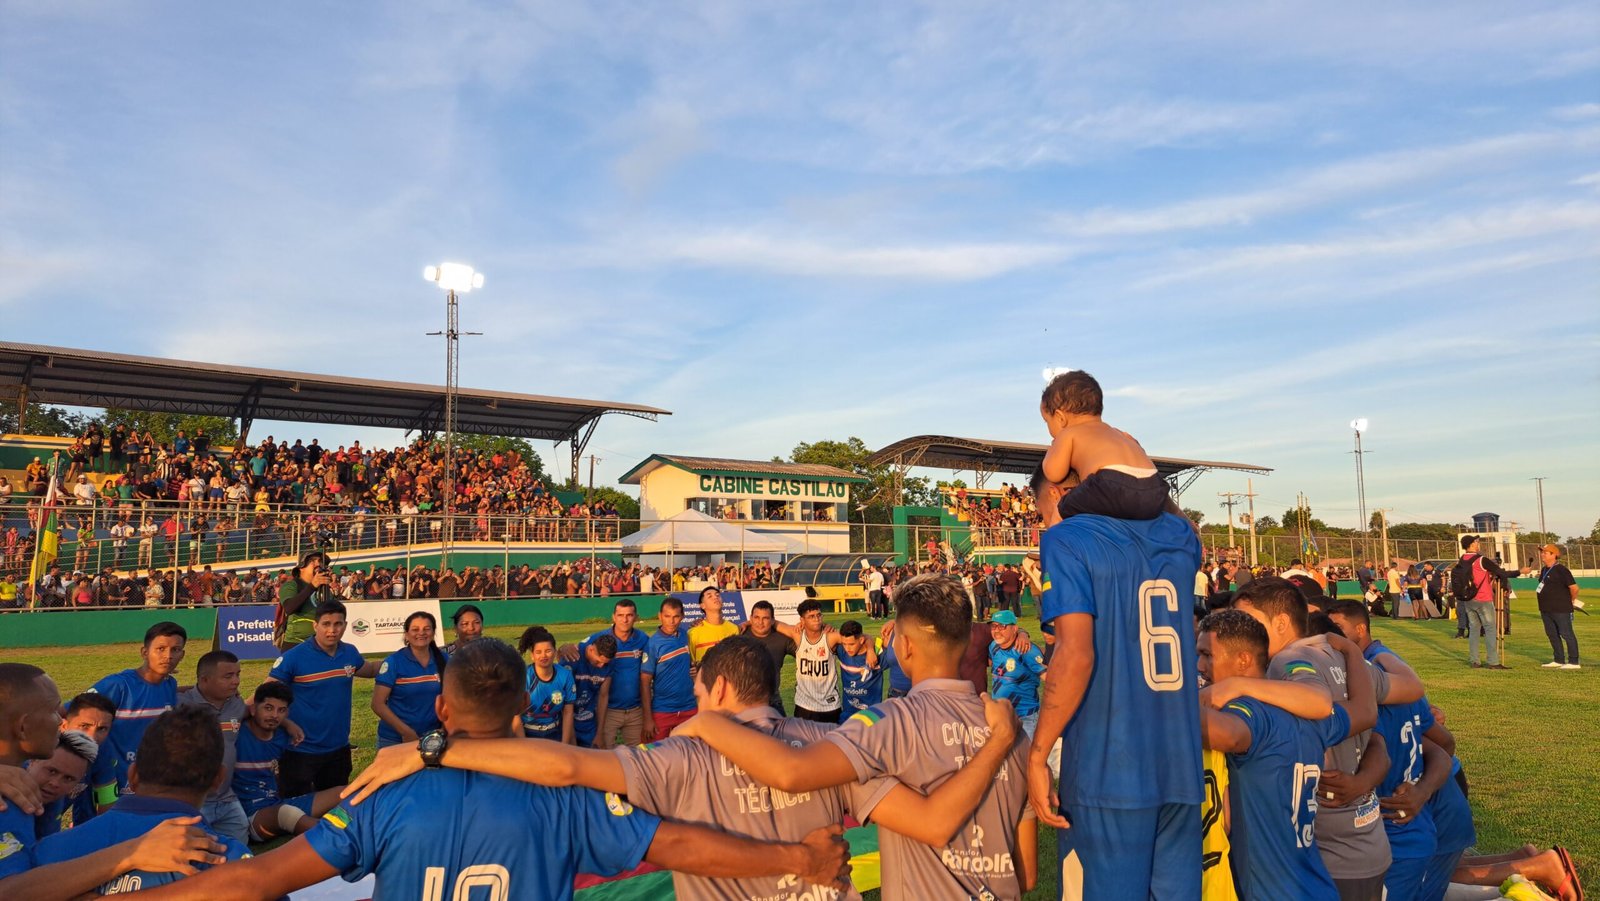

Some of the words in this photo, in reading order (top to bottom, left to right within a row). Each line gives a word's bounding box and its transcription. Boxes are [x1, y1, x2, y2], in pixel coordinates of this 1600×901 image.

[700, 474, 763, 494] CABINE
[768, 478, 846, 498] CASTILÃO
[227, 621, 236, 630] A
[1138, 579, 1183, 691] 6
